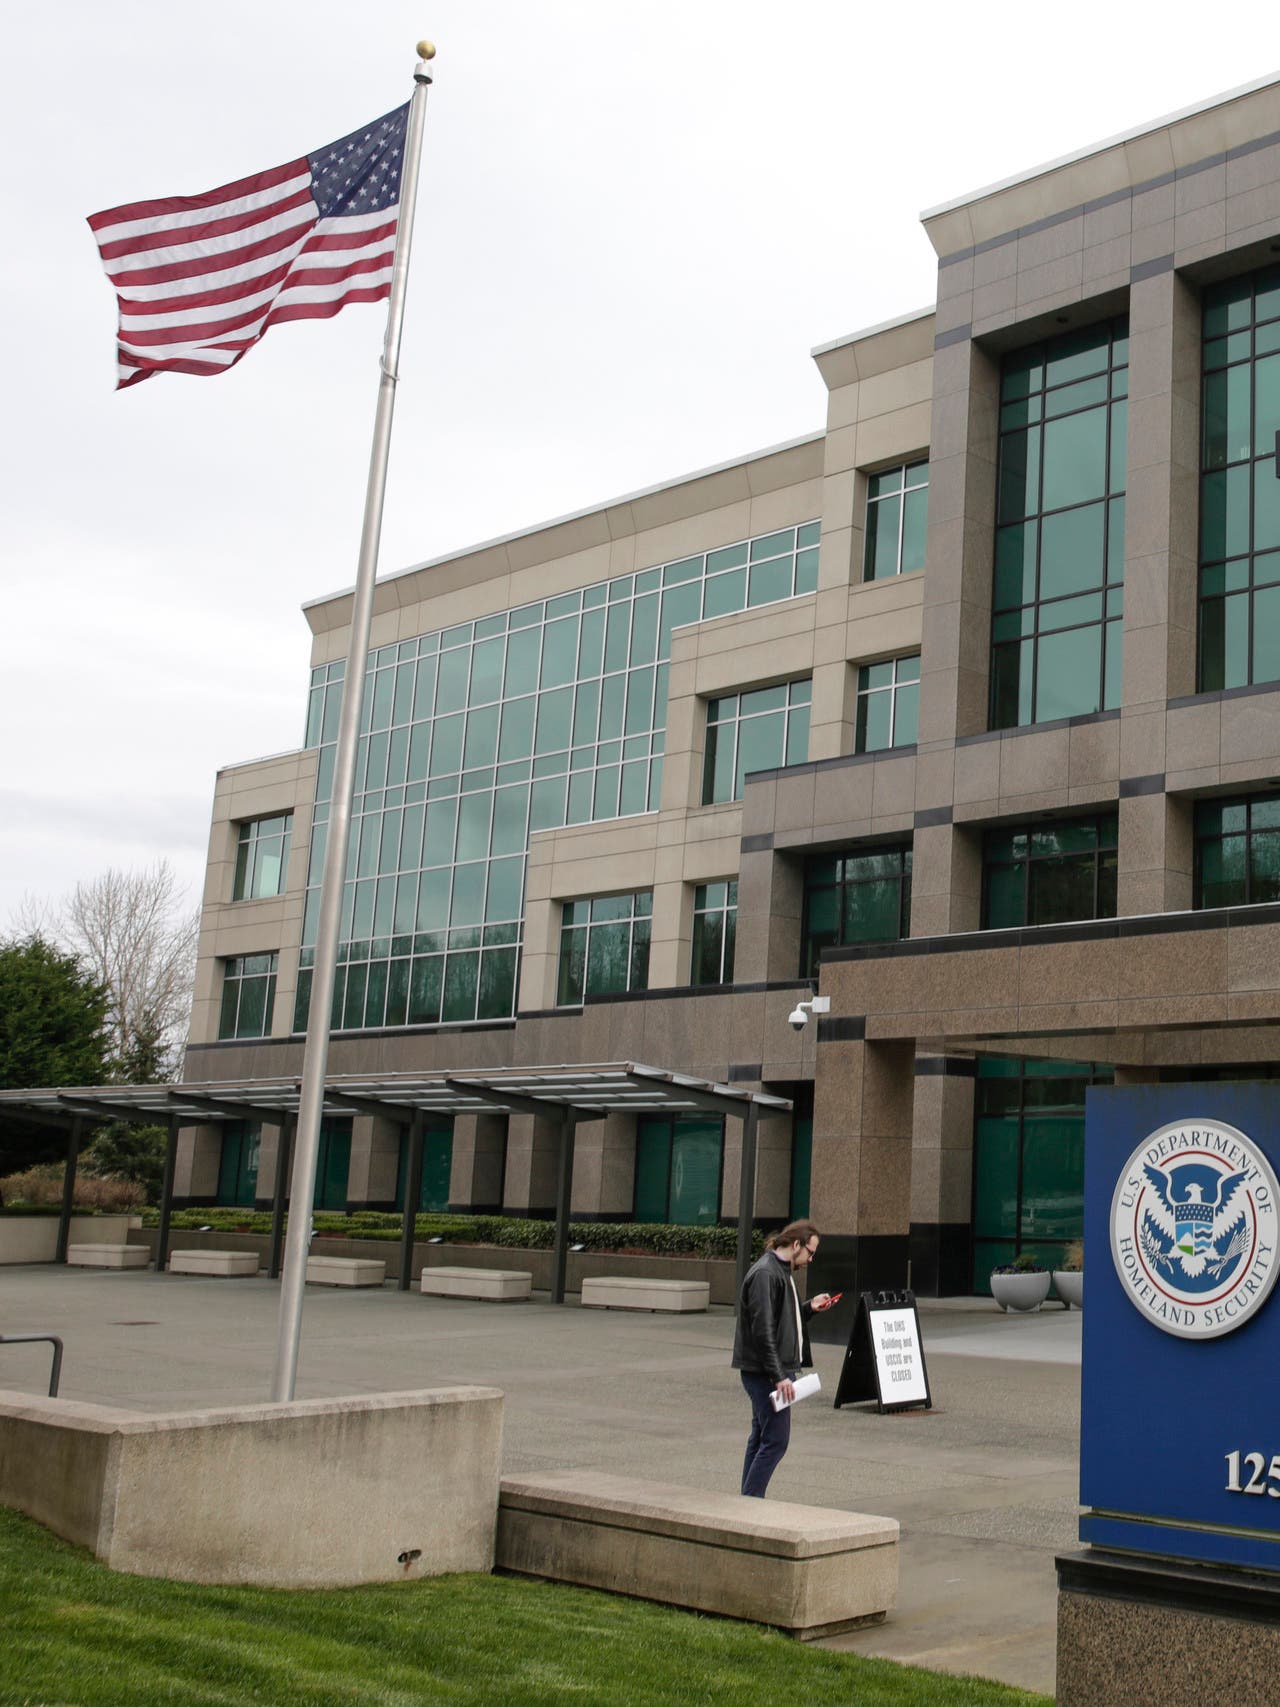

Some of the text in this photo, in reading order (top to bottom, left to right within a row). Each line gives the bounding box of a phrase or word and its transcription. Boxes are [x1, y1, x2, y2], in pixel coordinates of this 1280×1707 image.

[1121, 1130, 1273, 1214] U.S. DEPARTMENT OF
[1119, 1237, 1272, 1327] HOMELAND SECURITY
[884, 1321, 893, 1332] The
[881, 1337, 912, 1350] Building and
[903, 1354, 913, 1364] are
[891, 1369, 911, 1382] CLOSED
